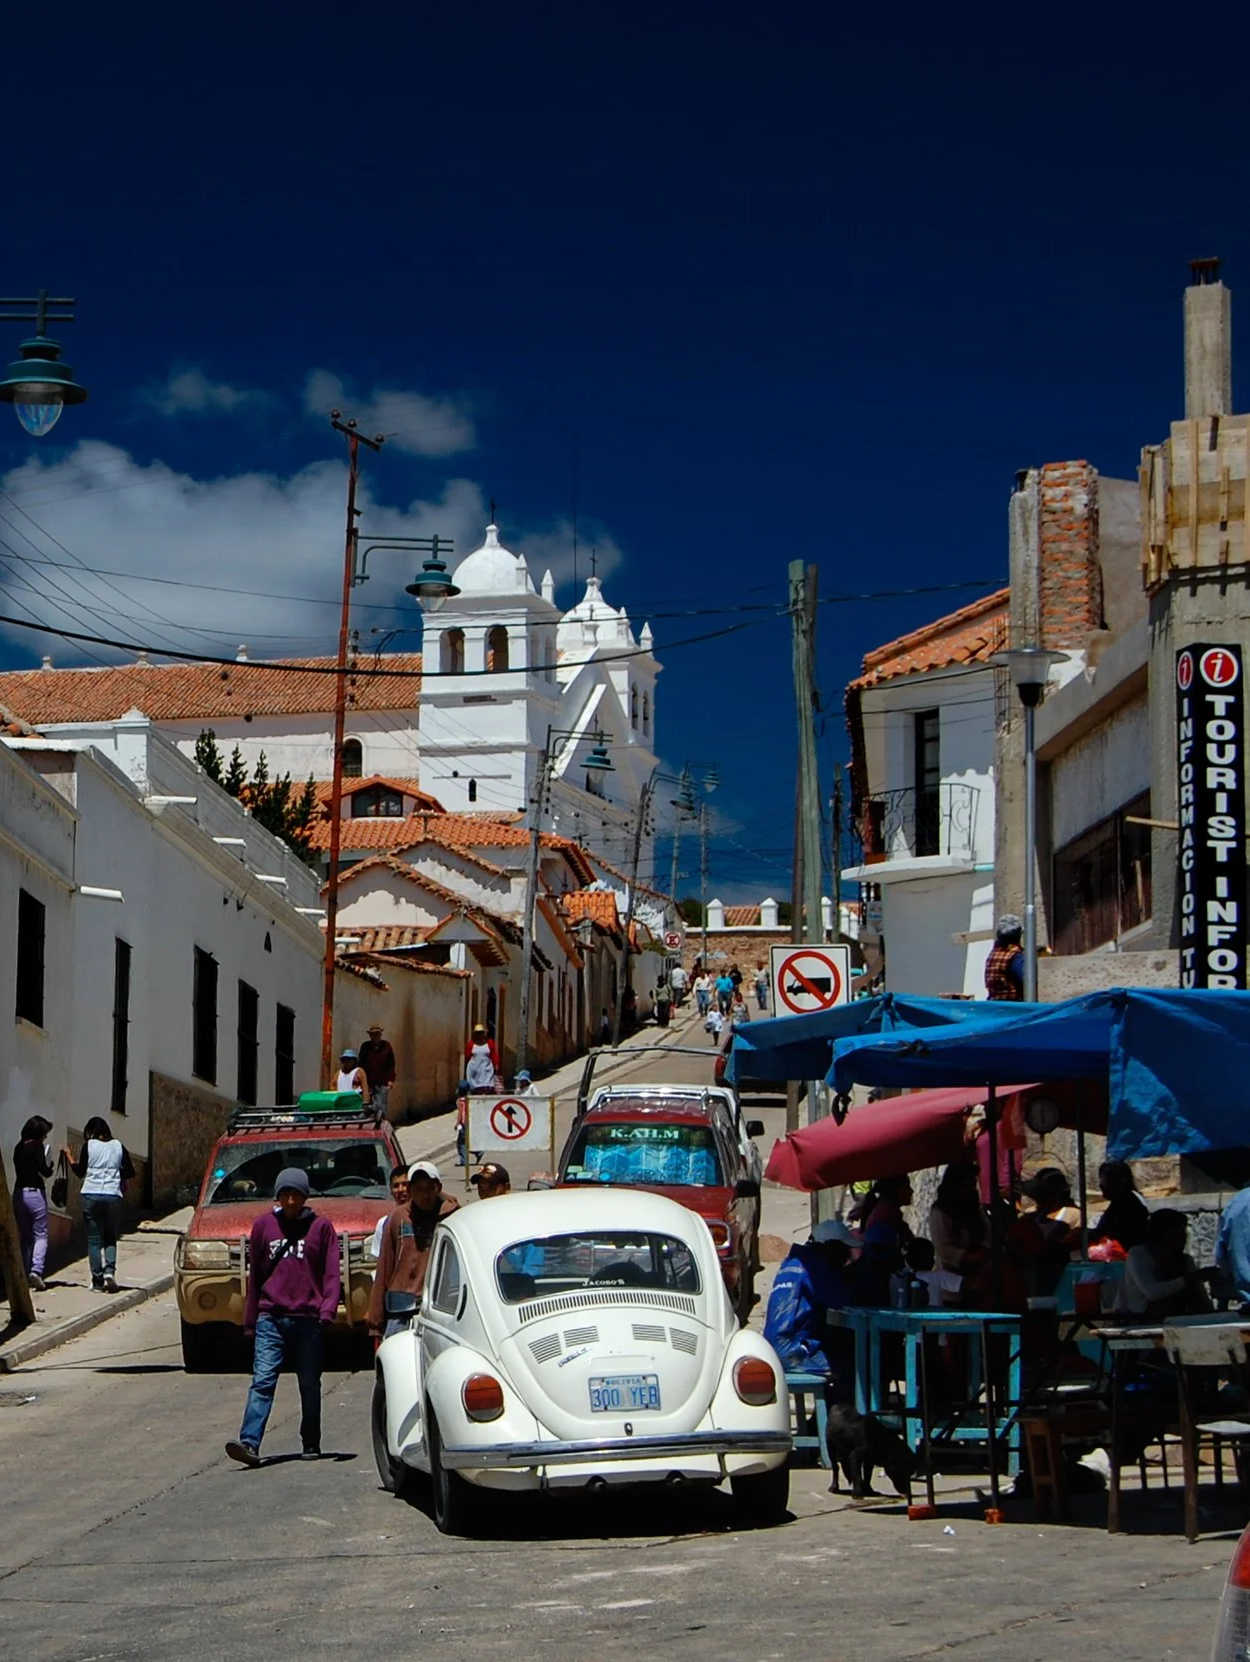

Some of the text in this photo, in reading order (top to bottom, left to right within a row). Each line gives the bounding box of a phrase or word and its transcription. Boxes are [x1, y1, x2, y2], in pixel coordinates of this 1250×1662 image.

[1180, 697, 1195, 937] INFORMACION
[1205, 694, 1237, 862] TOURIST
[592, 1385, 658, 1408] 300 YEB
